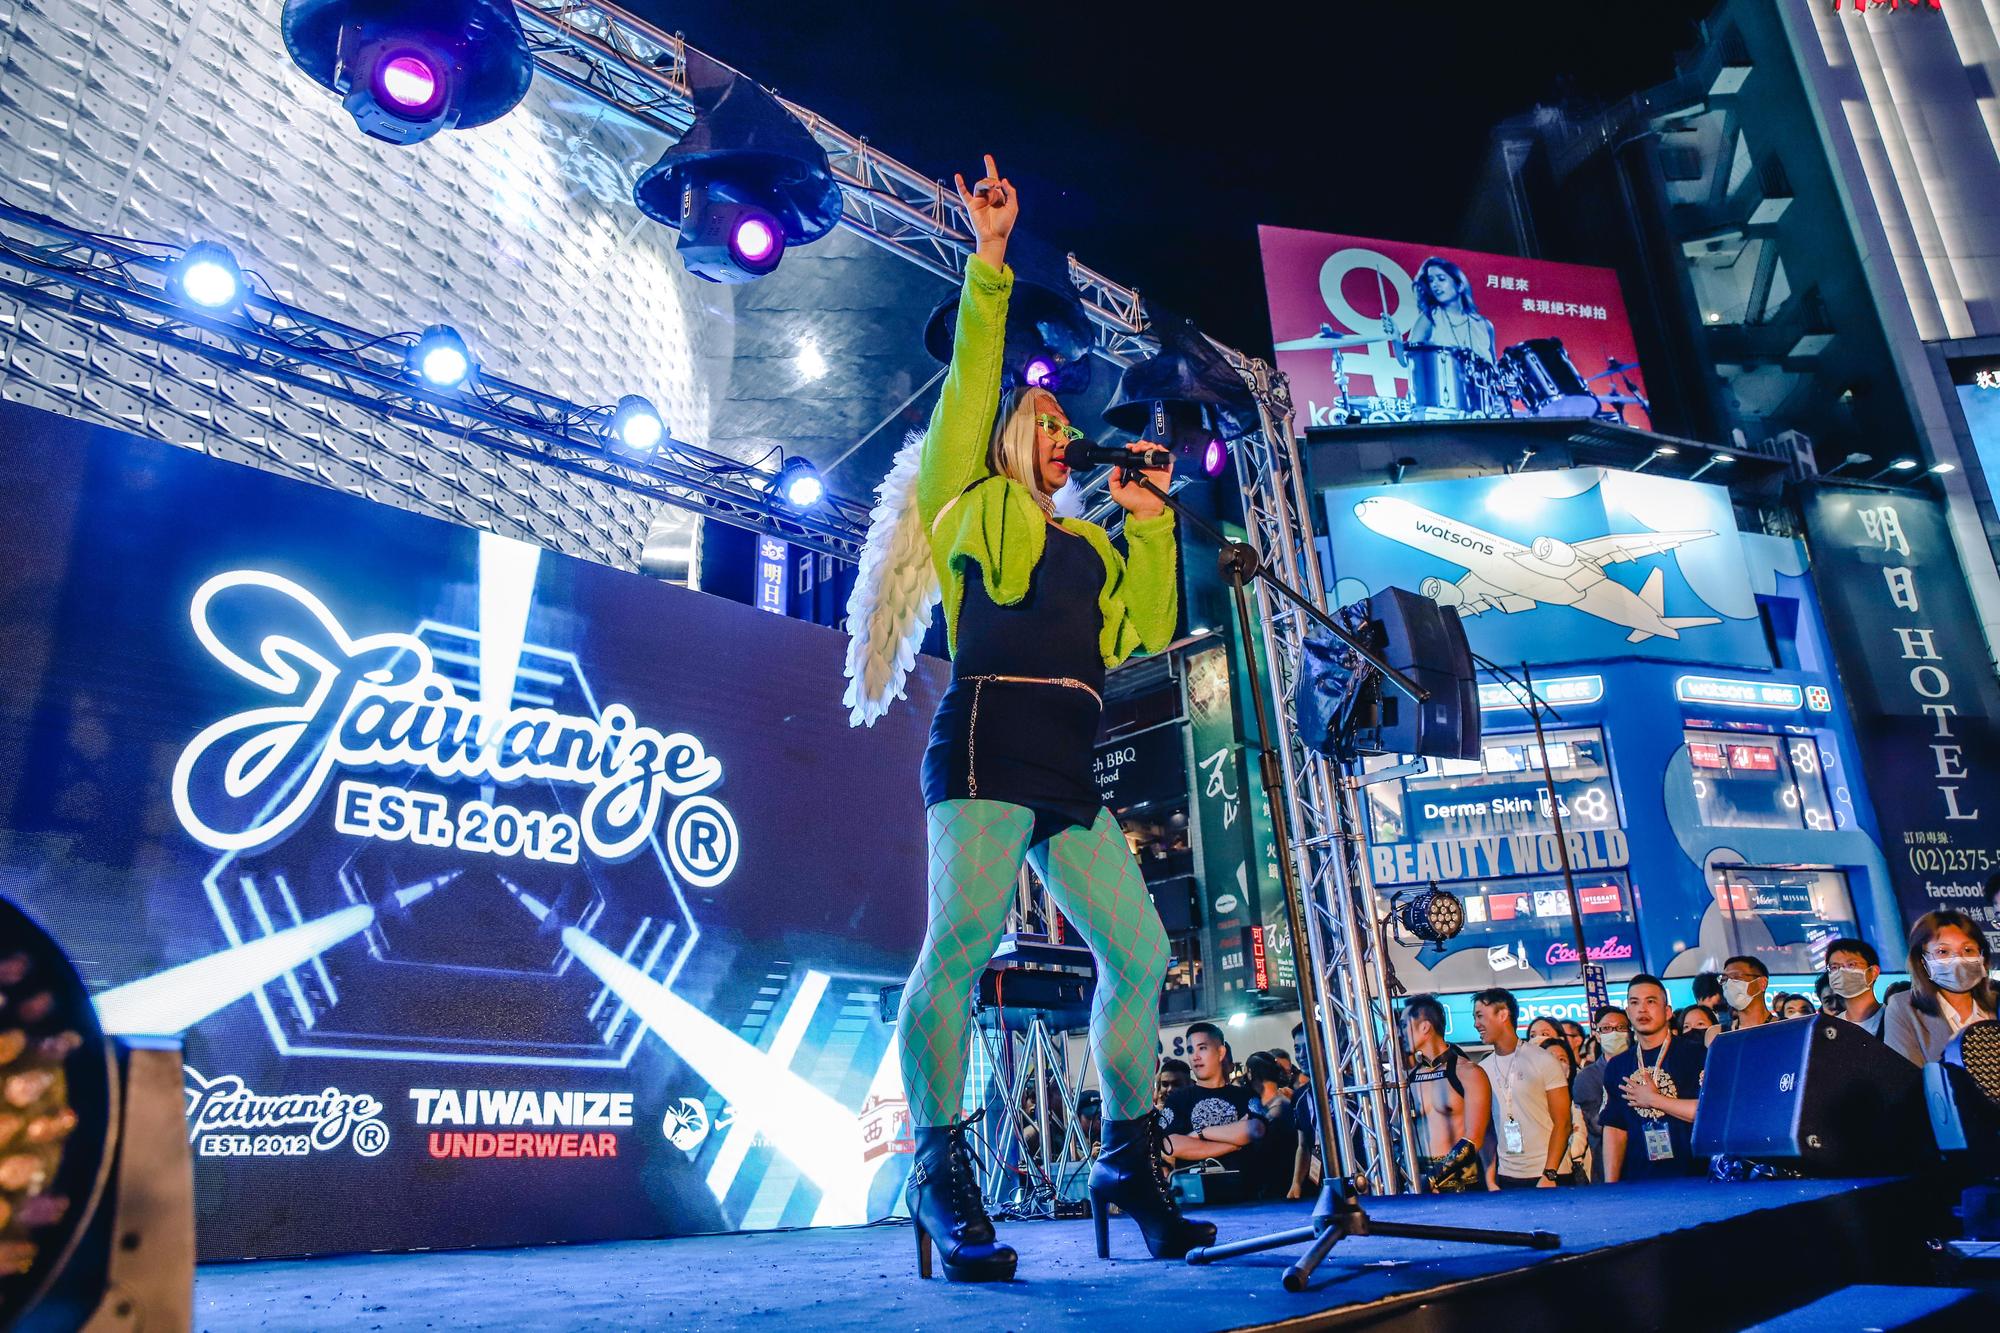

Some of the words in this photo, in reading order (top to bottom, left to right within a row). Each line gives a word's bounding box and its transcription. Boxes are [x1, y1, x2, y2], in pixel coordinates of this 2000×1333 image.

[1486, 274, 1529, 291] 月經來
[1522, 298, 1607, 320] 表現絕不掉拍
[1416, 520, 1494, 556] watsons
[763, 562, 782, 614] 明日
[1857, 506, 1918, 613] 明日
[1892, 628, 1979, 820] HOTEL
[172, 570, 723, 855] Taiwanize
[1106, 747, 1136, 769] BBQ
[1424, 801, 1486, 819] Derma
[1492, 797, 1532, 814] Skin
[461, 805, 577, 860] 2012
[1372, 836, 1500, 884] BEAUTY
[1509, 829, 1630, 880] WORLD
[1252, 927, 1268, 989] 可口可樂
[1546, 936, 1632, 964] Cosetics
[1518, 1002, 1590, 1022] atsons
[409, 1089, 634, 1127] TAIWANIZE
[201, 1136, 251, 1154] EST.
[255, 1136, 309, 1154] 2012
[428, 1133, 618, 1158] UNDERWEAR
